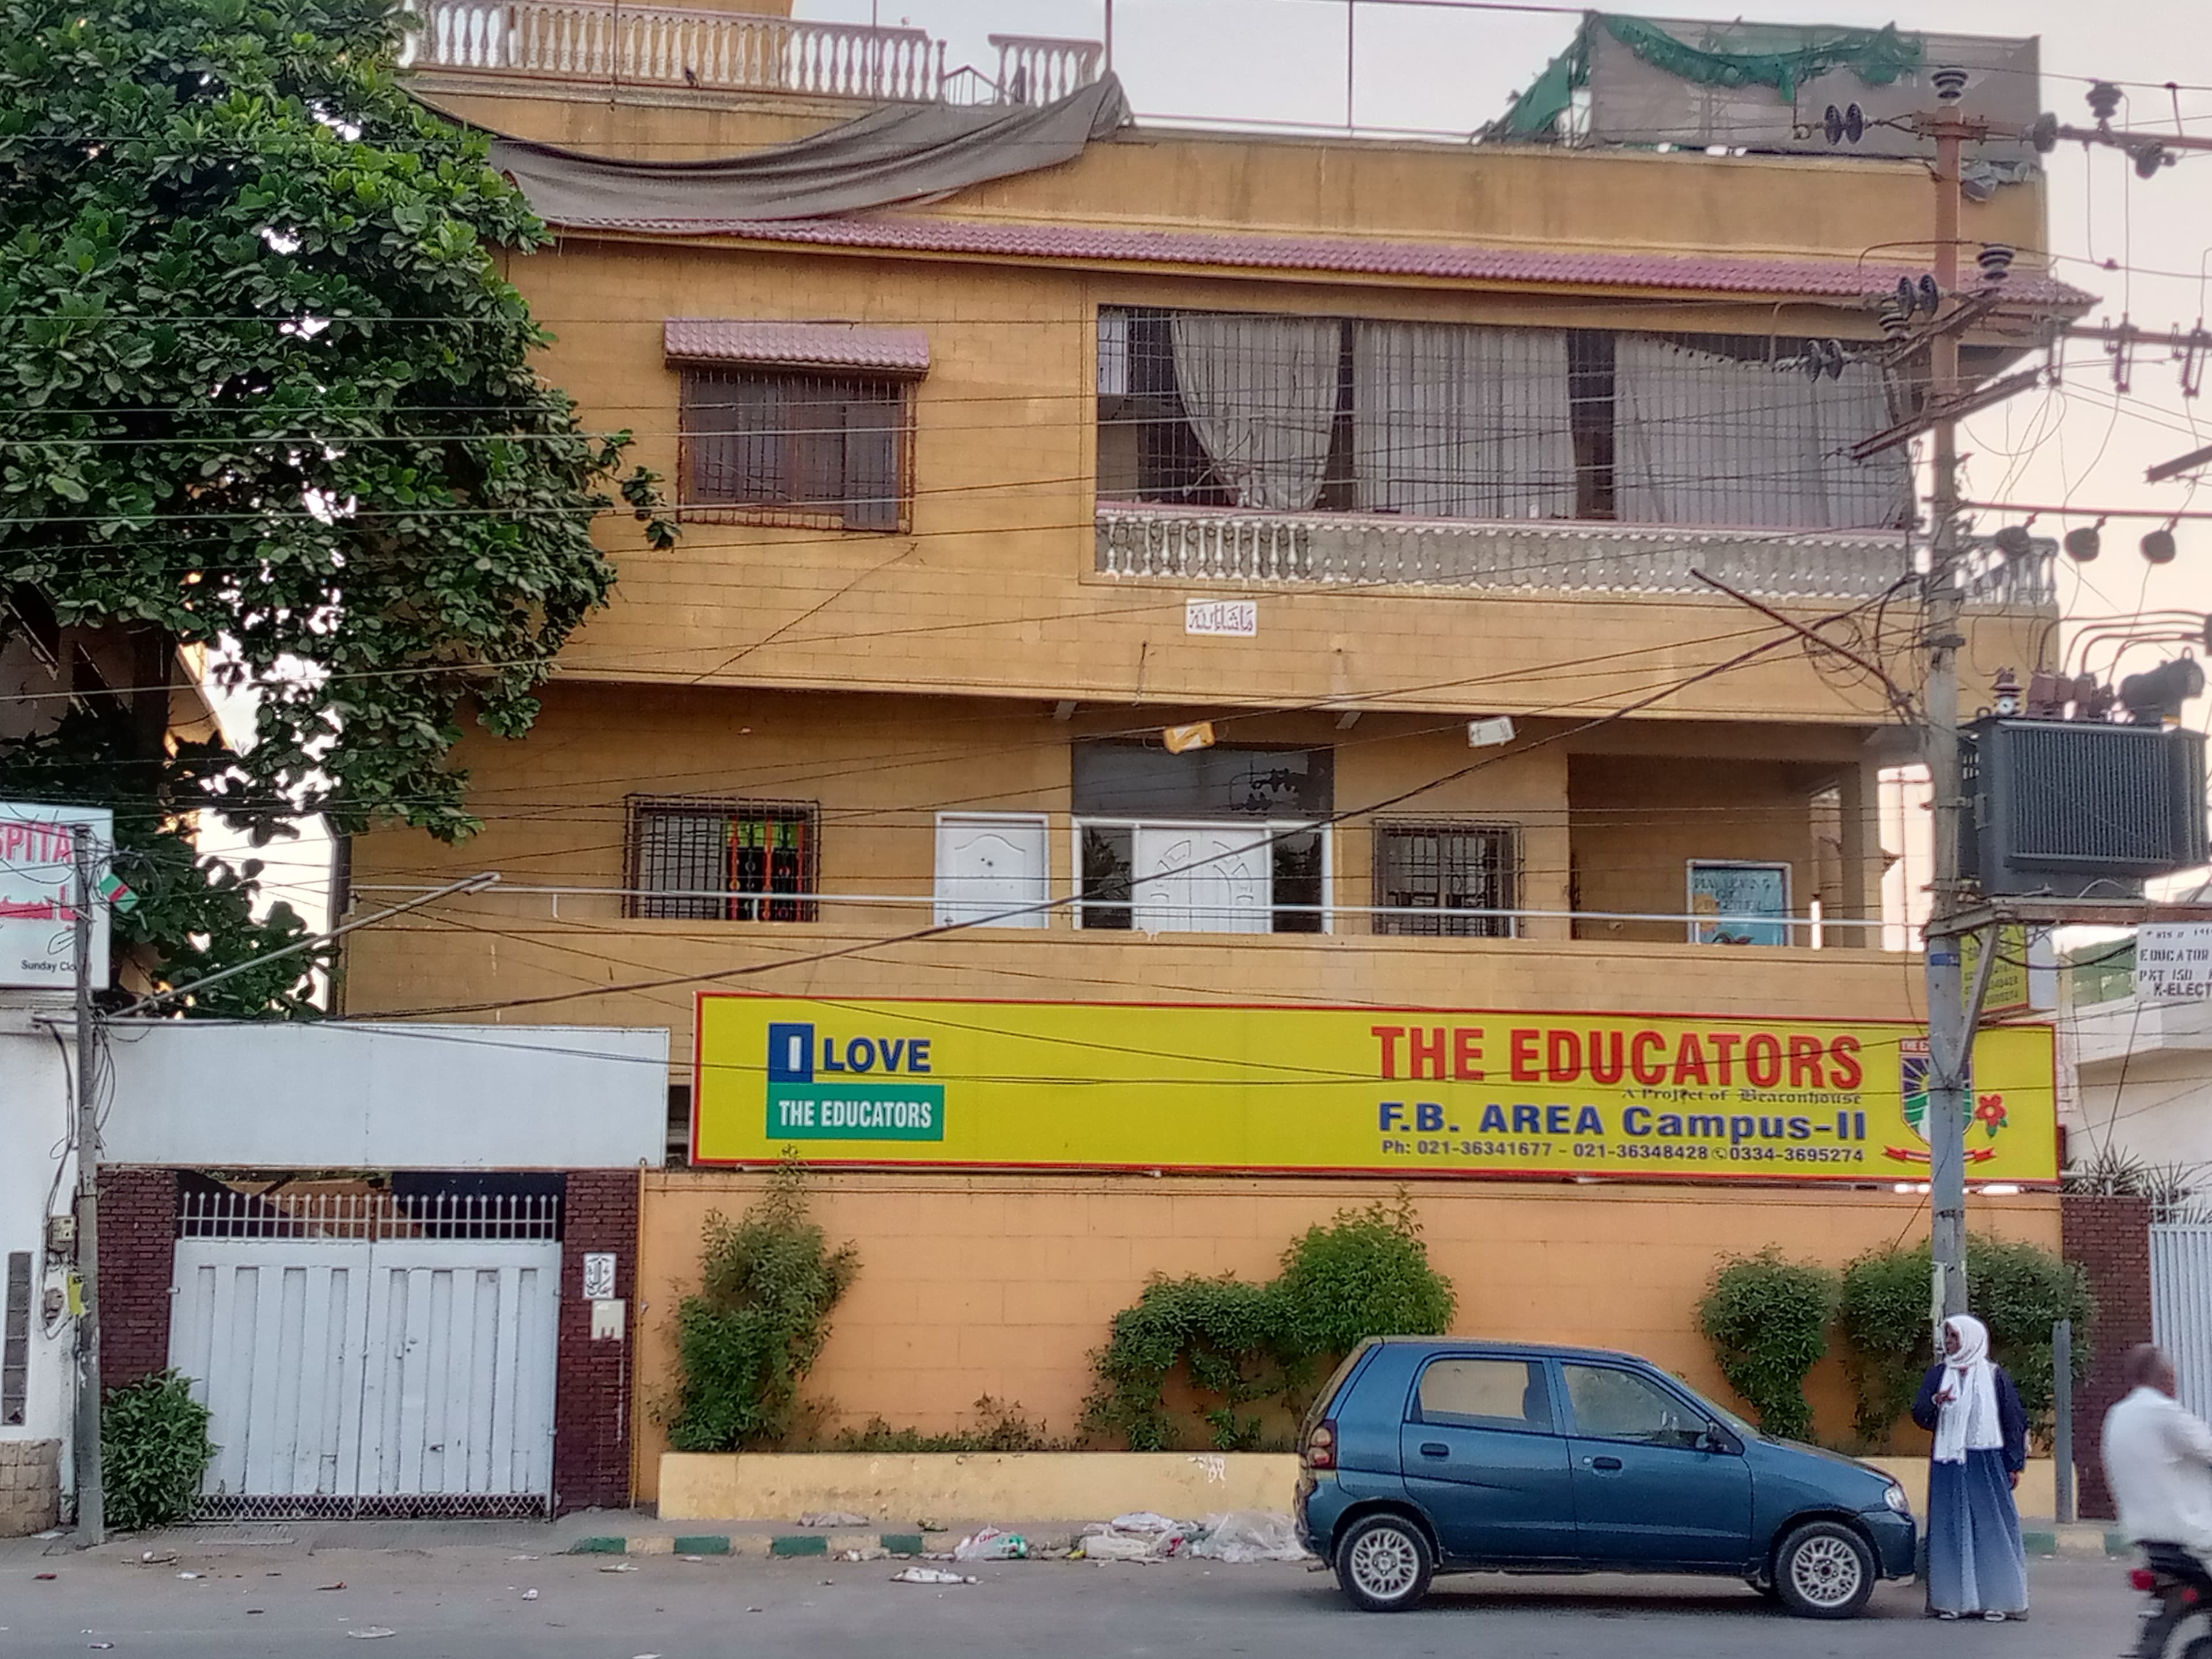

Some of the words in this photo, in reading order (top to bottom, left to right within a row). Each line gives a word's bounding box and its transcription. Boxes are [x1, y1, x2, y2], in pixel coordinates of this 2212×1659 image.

[0, 822, 73, 863] PITA
[21, 960, 57, 974] Sunday
[824, 1037, 931, 1074] LOVE
[1371, 1027, 1485, 1081] THE
[1510, 1029, 1863, 1090] EDUCATORS
[1710, 1089, 1728, 1100] of
[1738, 1089, 1862, 1105] Beaconhouse
[779, 1100, 815, 1127] THE
[821, 1100, 932, 1128] EDUCATORS
[1379, 1102, 1460, 1132] F.B.
[1479, 1104, 1604, 1135] AREA
[1623, 1105, 1866, 1145] Campus-II
[1382, 1140, 1411, 1155] Ph:
[1418, 1141, 1552, 1157] 021-36341677
[1574, 1142, 1708, 1160] 021-36348428
[1730, 1146, 1863, 1162] 0334-3695274
